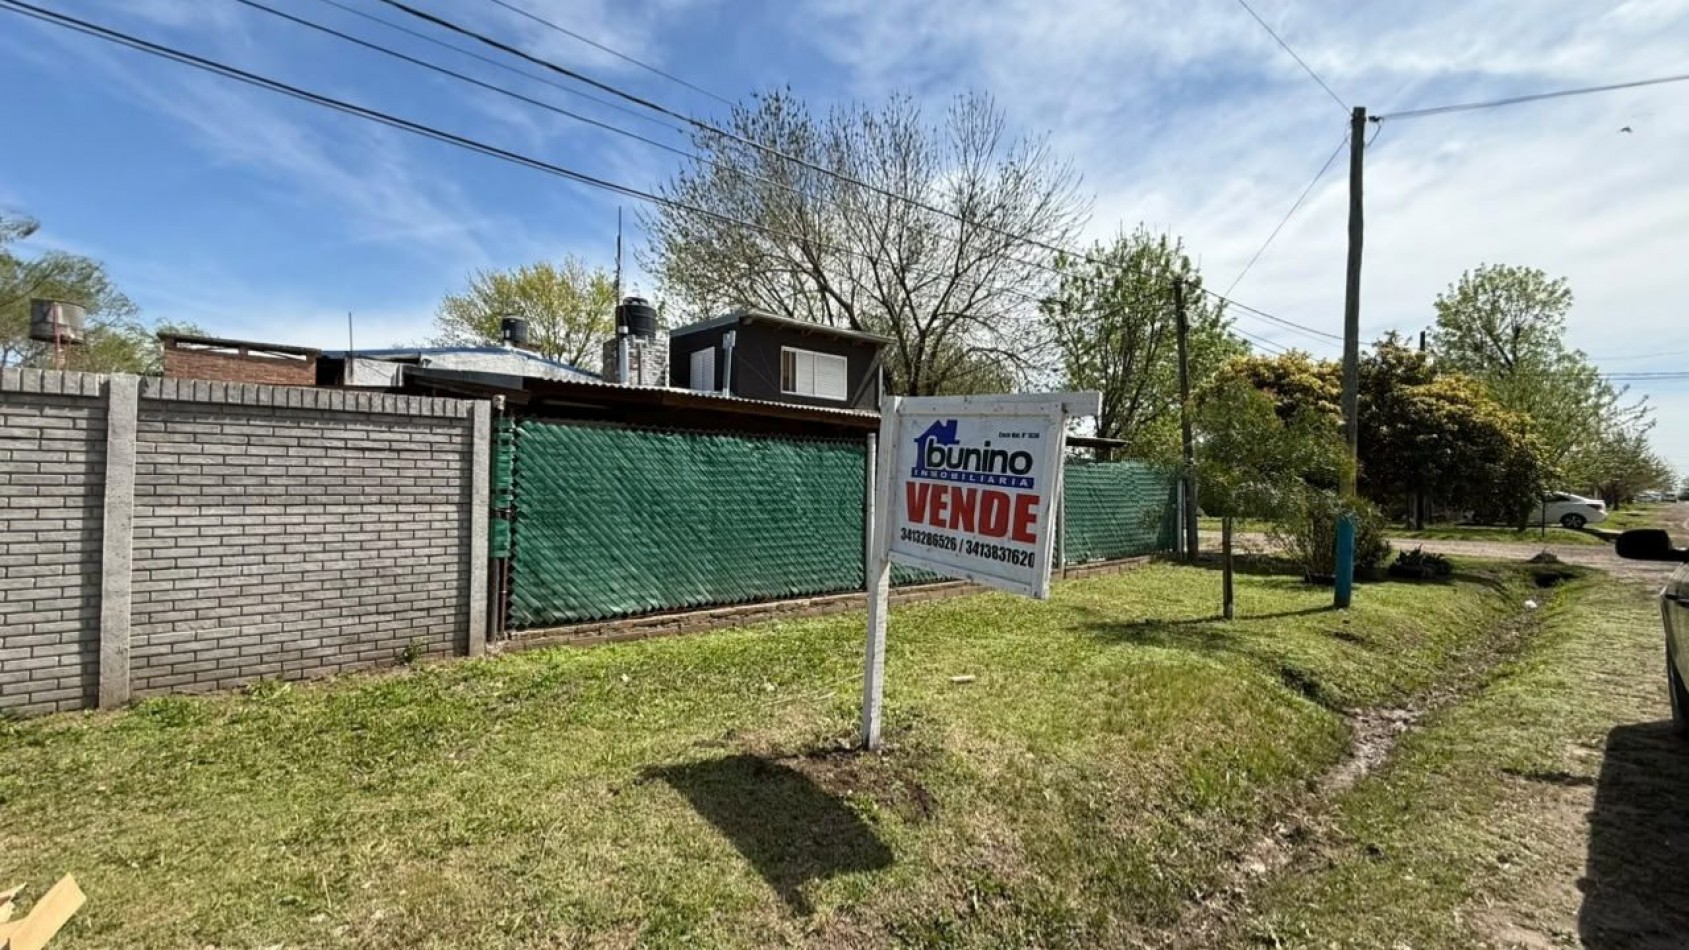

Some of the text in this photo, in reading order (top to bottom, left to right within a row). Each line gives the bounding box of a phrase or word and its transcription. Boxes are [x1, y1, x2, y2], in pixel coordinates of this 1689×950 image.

[927, 438, 1033, 475] bunino
[914, 469, 1029, 487] INMOBILIARIA
[906, 481, 1040, 545] VENDE
[900, 528, 1035, 568] 3413286526 / 3413837620
